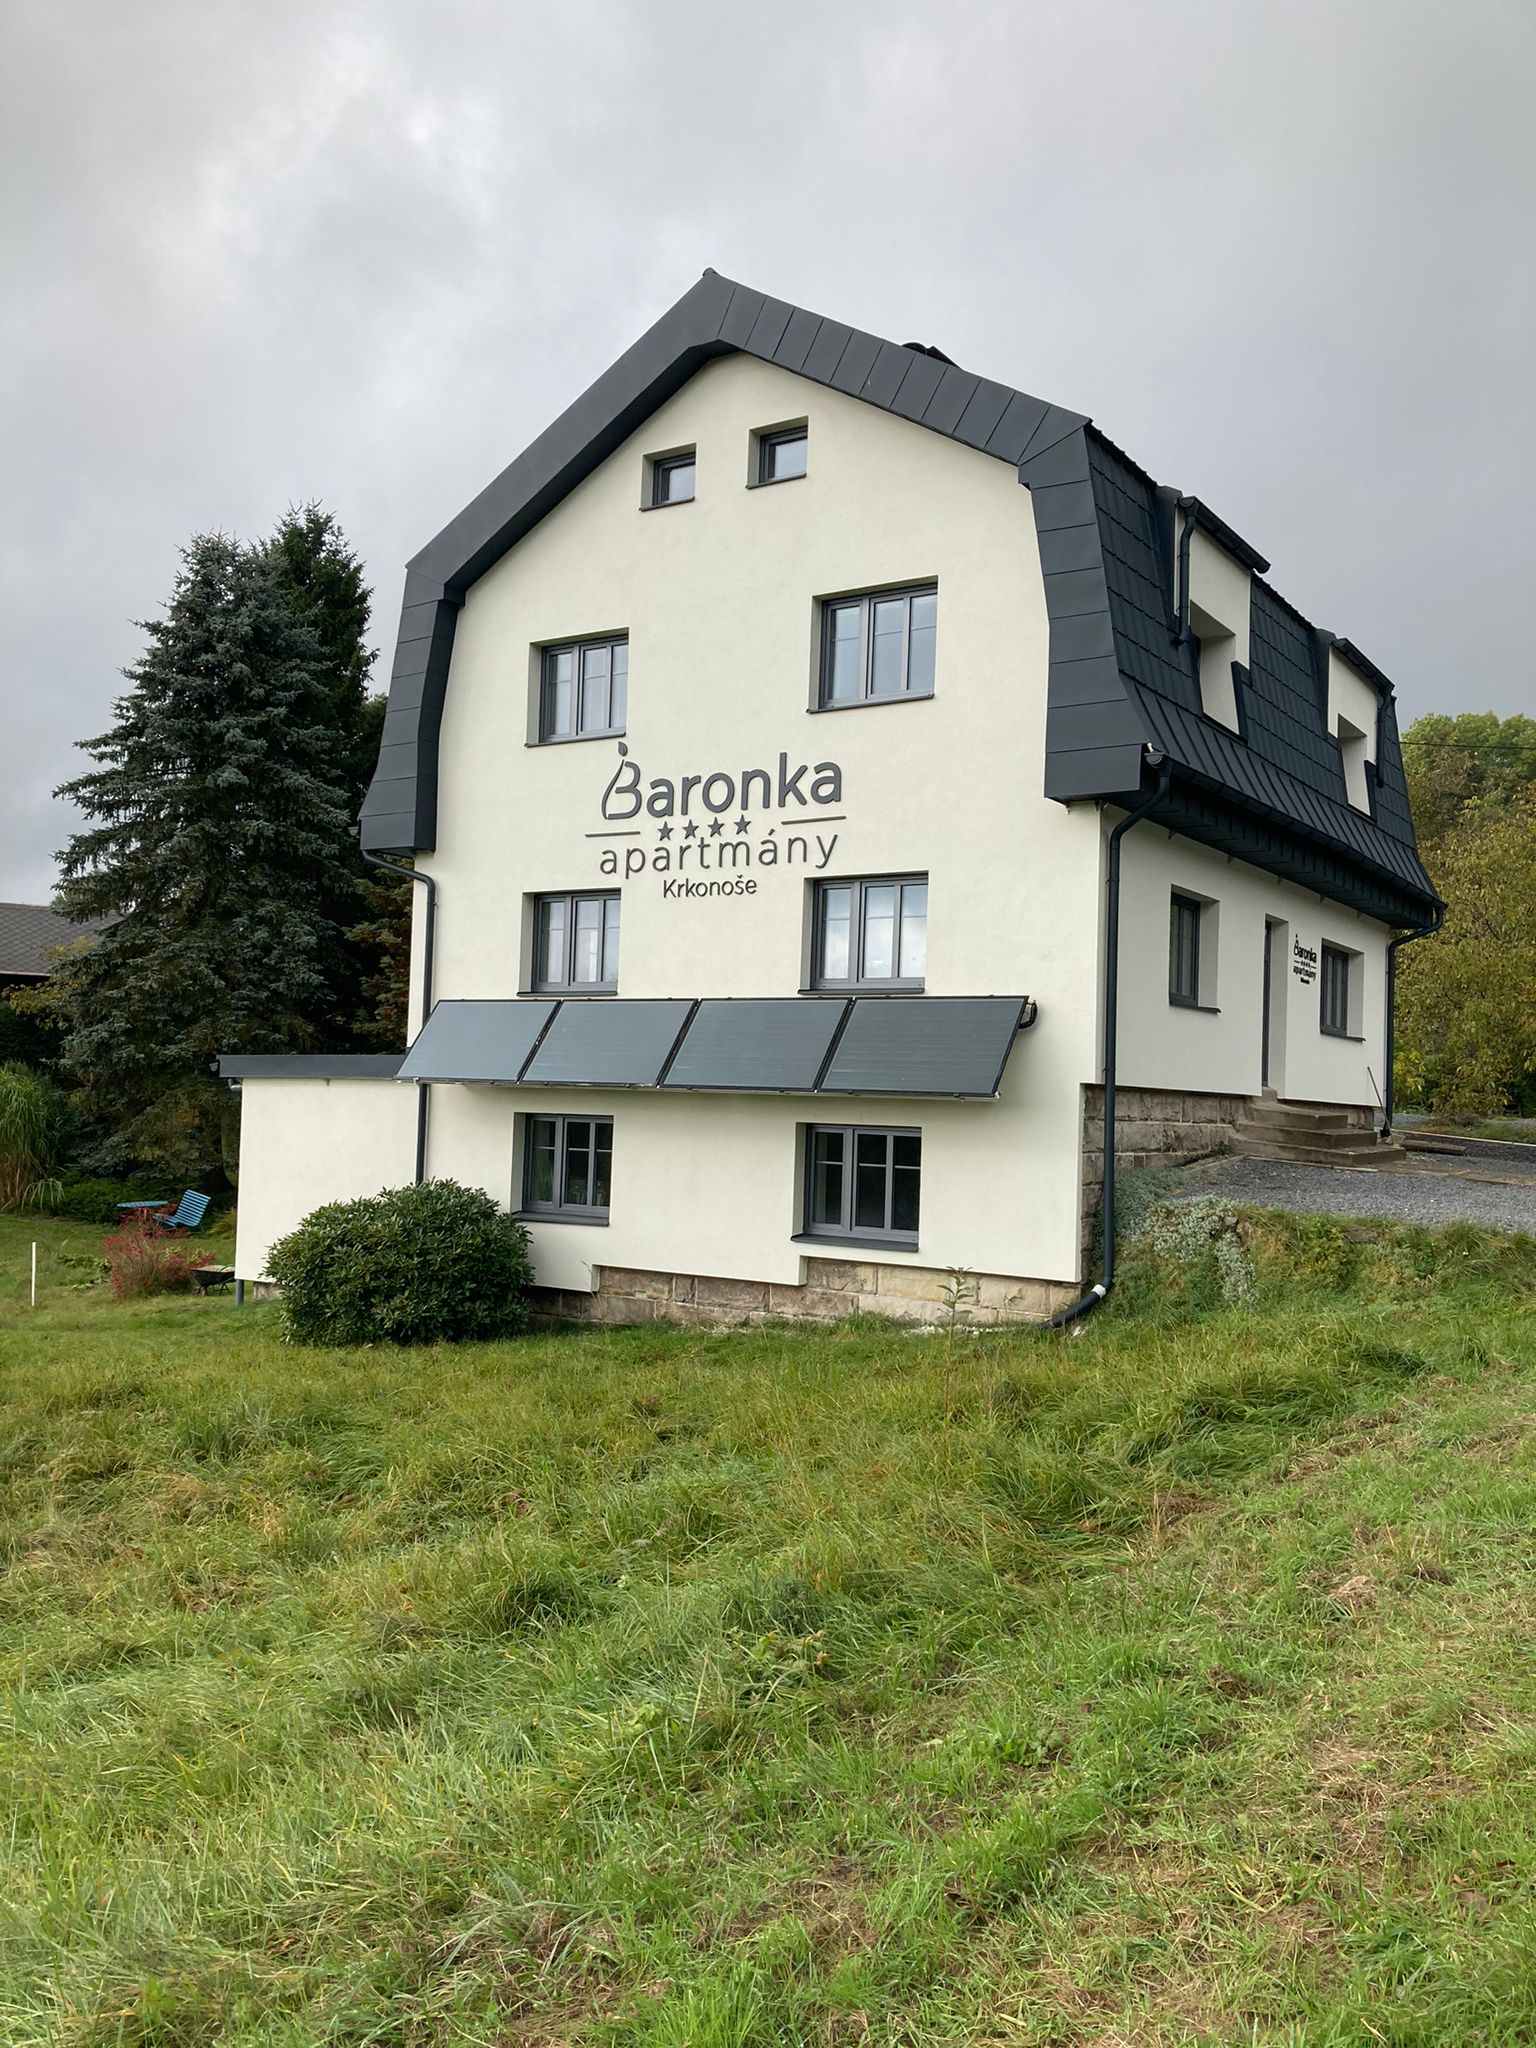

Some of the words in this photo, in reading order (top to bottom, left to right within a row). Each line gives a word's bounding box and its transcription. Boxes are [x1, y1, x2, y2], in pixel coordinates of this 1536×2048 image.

[601, 751, 842, 820] Baronka
[599, 828, 838, 879] apartmány
[663, 875, 757, 898] Krkonoše
[1294, 939, 1317, 963] Baronka
